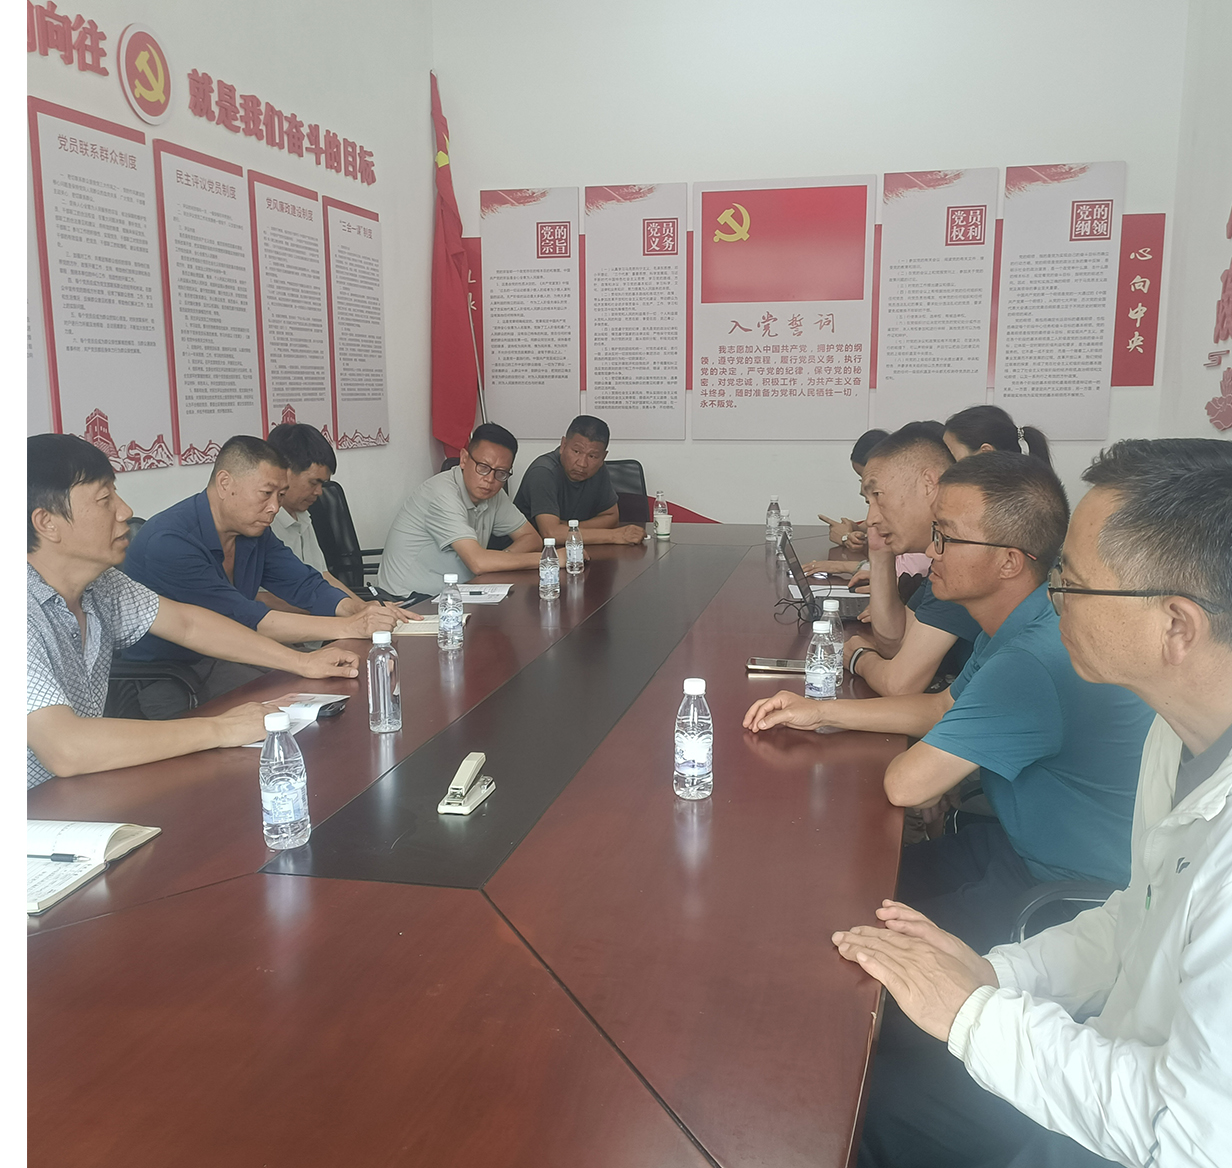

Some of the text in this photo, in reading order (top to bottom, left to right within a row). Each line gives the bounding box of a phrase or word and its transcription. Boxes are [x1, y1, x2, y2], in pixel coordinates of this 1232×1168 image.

[27, 0, 377, 186] 向往 就是我们奋斗的目标
[57, 133, 138, 171] 党员联系群众制度
[175, 169, 237, 200] 民主评议党员制度
[951, 210, 982, 226] 党员
[1076, 204, 1109, 221] 党的
[540, 226, 567, 240] 党的
[647, 222, 674, 237] 党员
[950, 226, 982, 241] 权利
[1075, 220, 1108, 236] 纲领
[540, 240, 567, 254] 宗旨
[647, 237, 675, 251] 义务
[1126, 247, 1153, 354] 心向中央
[728, 311, 835, 338] 入党誓词
